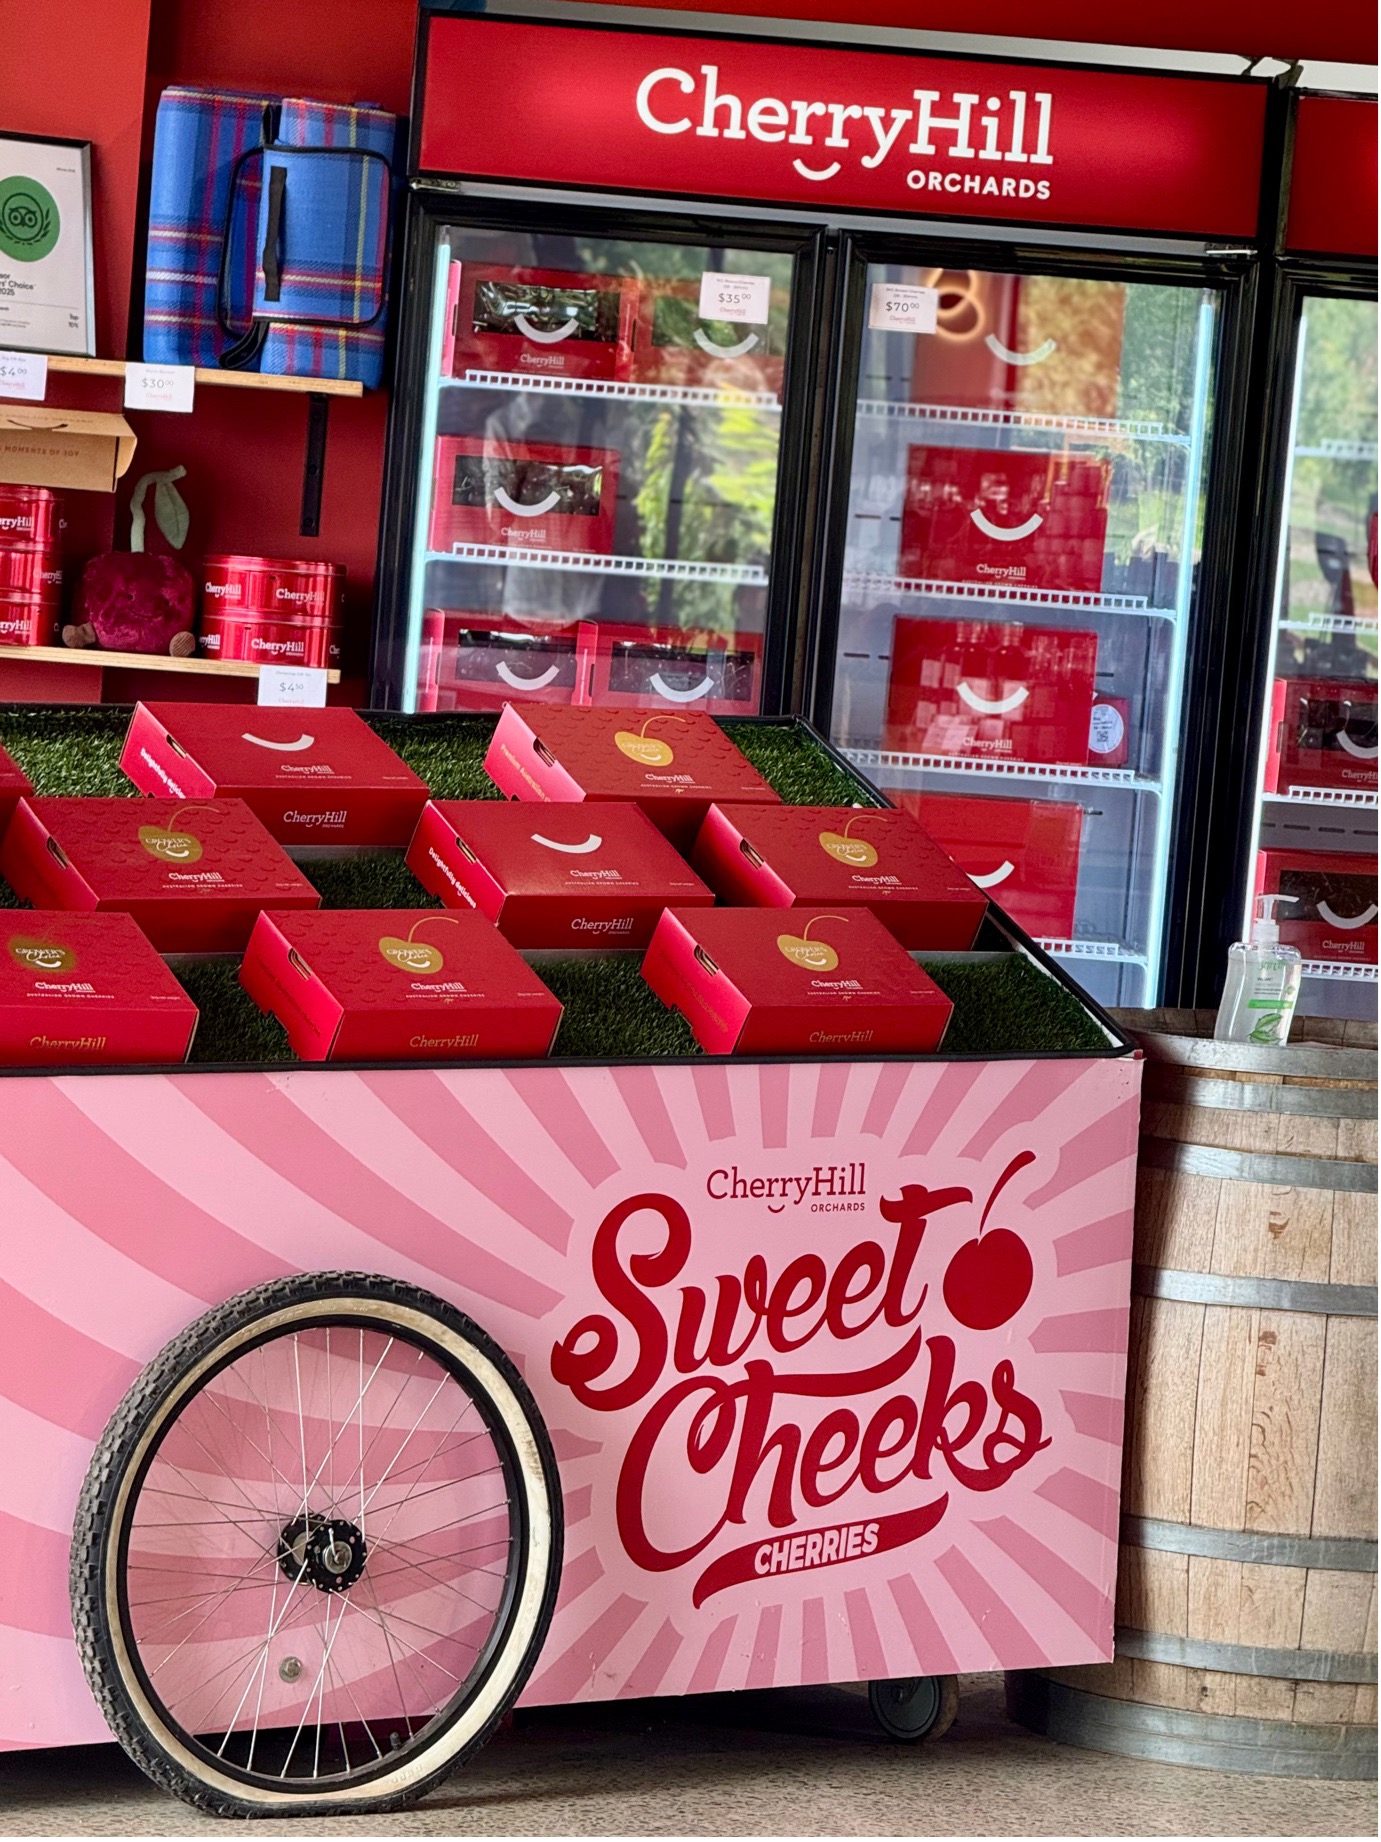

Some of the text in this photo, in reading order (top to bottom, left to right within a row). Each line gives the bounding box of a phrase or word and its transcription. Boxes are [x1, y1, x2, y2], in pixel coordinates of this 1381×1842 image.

[636, 64, 1054, 168] CherryHill
[906, 169, 1051, 200] ORCHARDS
[8, 280, 34, 290] Choice
[520, 354, 565, 367] CherryHill
[501, 527, 547, 541] CherryHill
[976, 563, 1027, 577] CherryHill
[205, 582, 242, 596] CherryHill
[276, 588, 325, 602] CherryHill
[251, 638, 304, 653] CherryHill
[963, 737, 1013, 750] CherryHill
[281, 764, 334, 775] CherryHill
[645, 774, 694, 783] CherryHill
[283, 810, 348, 825] CherryHill
[168, 872, 223, 882] CherryHill
[428, 846, 477, 909] Delightfully delicious
[570, 870, 621, 879] CherryHill
[852, 875, 900, 884] CherryHill
[571, 917, 634, 932] CherryHill
[1323, 939, 1366, 952] CherryHill
[35, 981, 93, 992] CherryHill
[411, 982, 465, 992] CherryHill
[811, 980, 862, 989] CherryHill
[30, 1035, 107, 1050] CherryHill
[409, 1034, 479, 1048] CherryHill
[809, 1030, 873, 1043] CherryHill
[706, 1163, 866, 1204] CherryHill
[810, 1202, 866, 1213] ORCHARDS
[551, 1184, 973, 1412] Sweet
[616, 1326, 1053, 1573] Cheeks
[754, 1522, 880, 1576] CHERRIES
